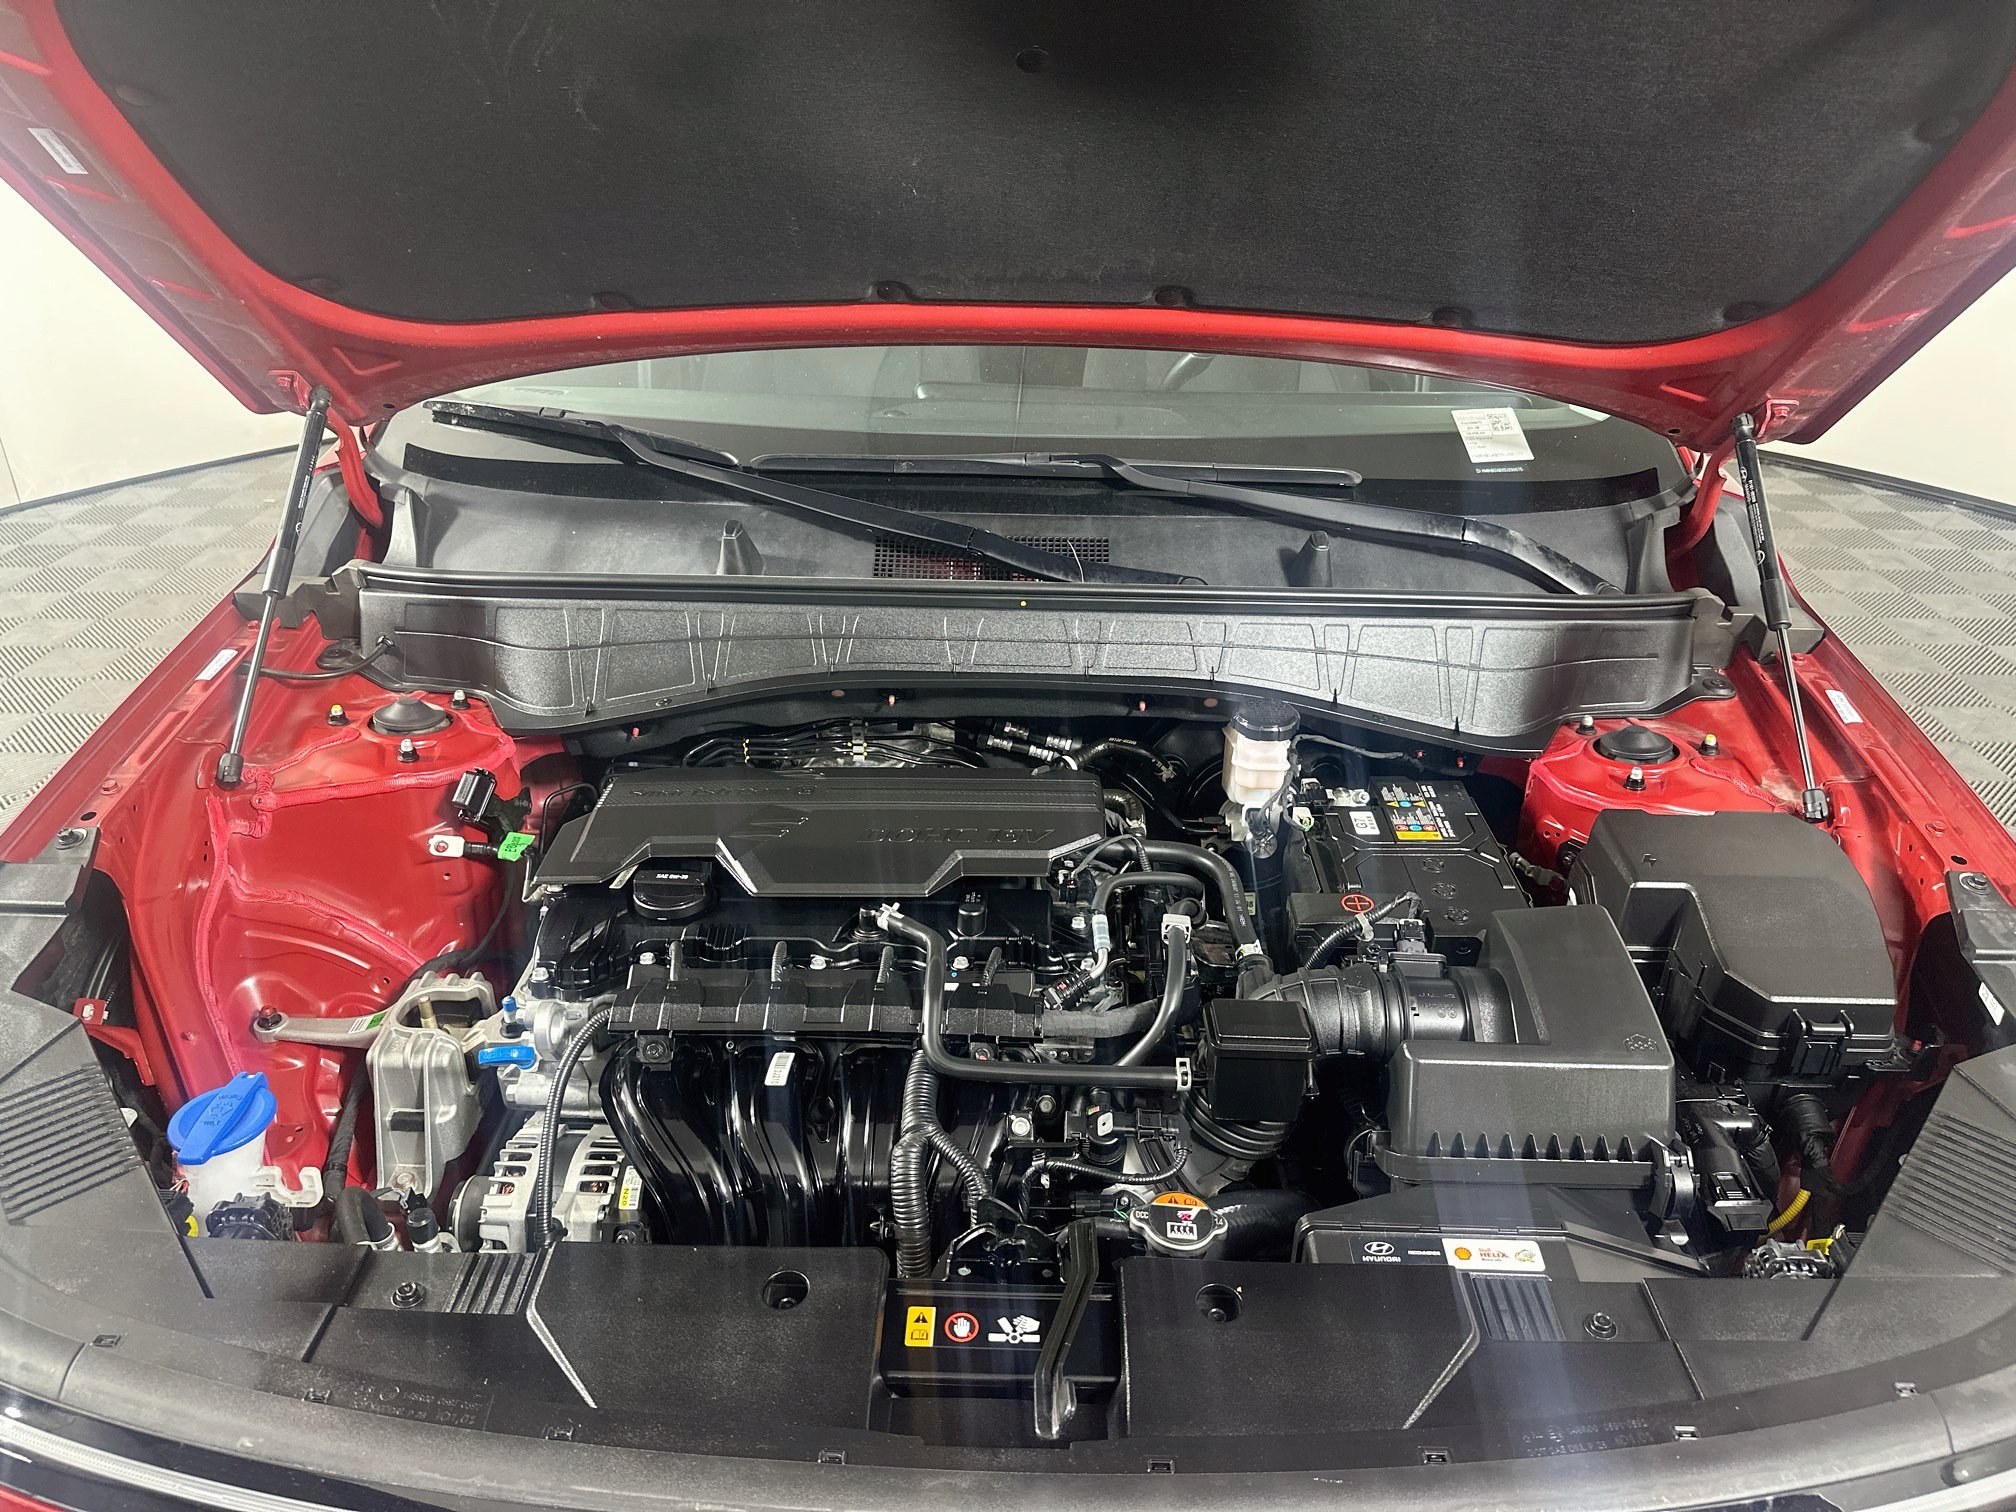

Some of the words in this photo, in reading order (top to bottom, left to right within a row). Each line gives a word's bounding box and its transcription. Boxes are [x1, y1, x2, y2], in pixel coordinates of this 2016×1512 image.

[857, 827, 978, 843] DOHC
[1135, 1210, 1149, 1219] DCC
[1362, 1255, 1402, 1263] HYUNDAI
[1479, 1251, 1508, 1259] HELIX
